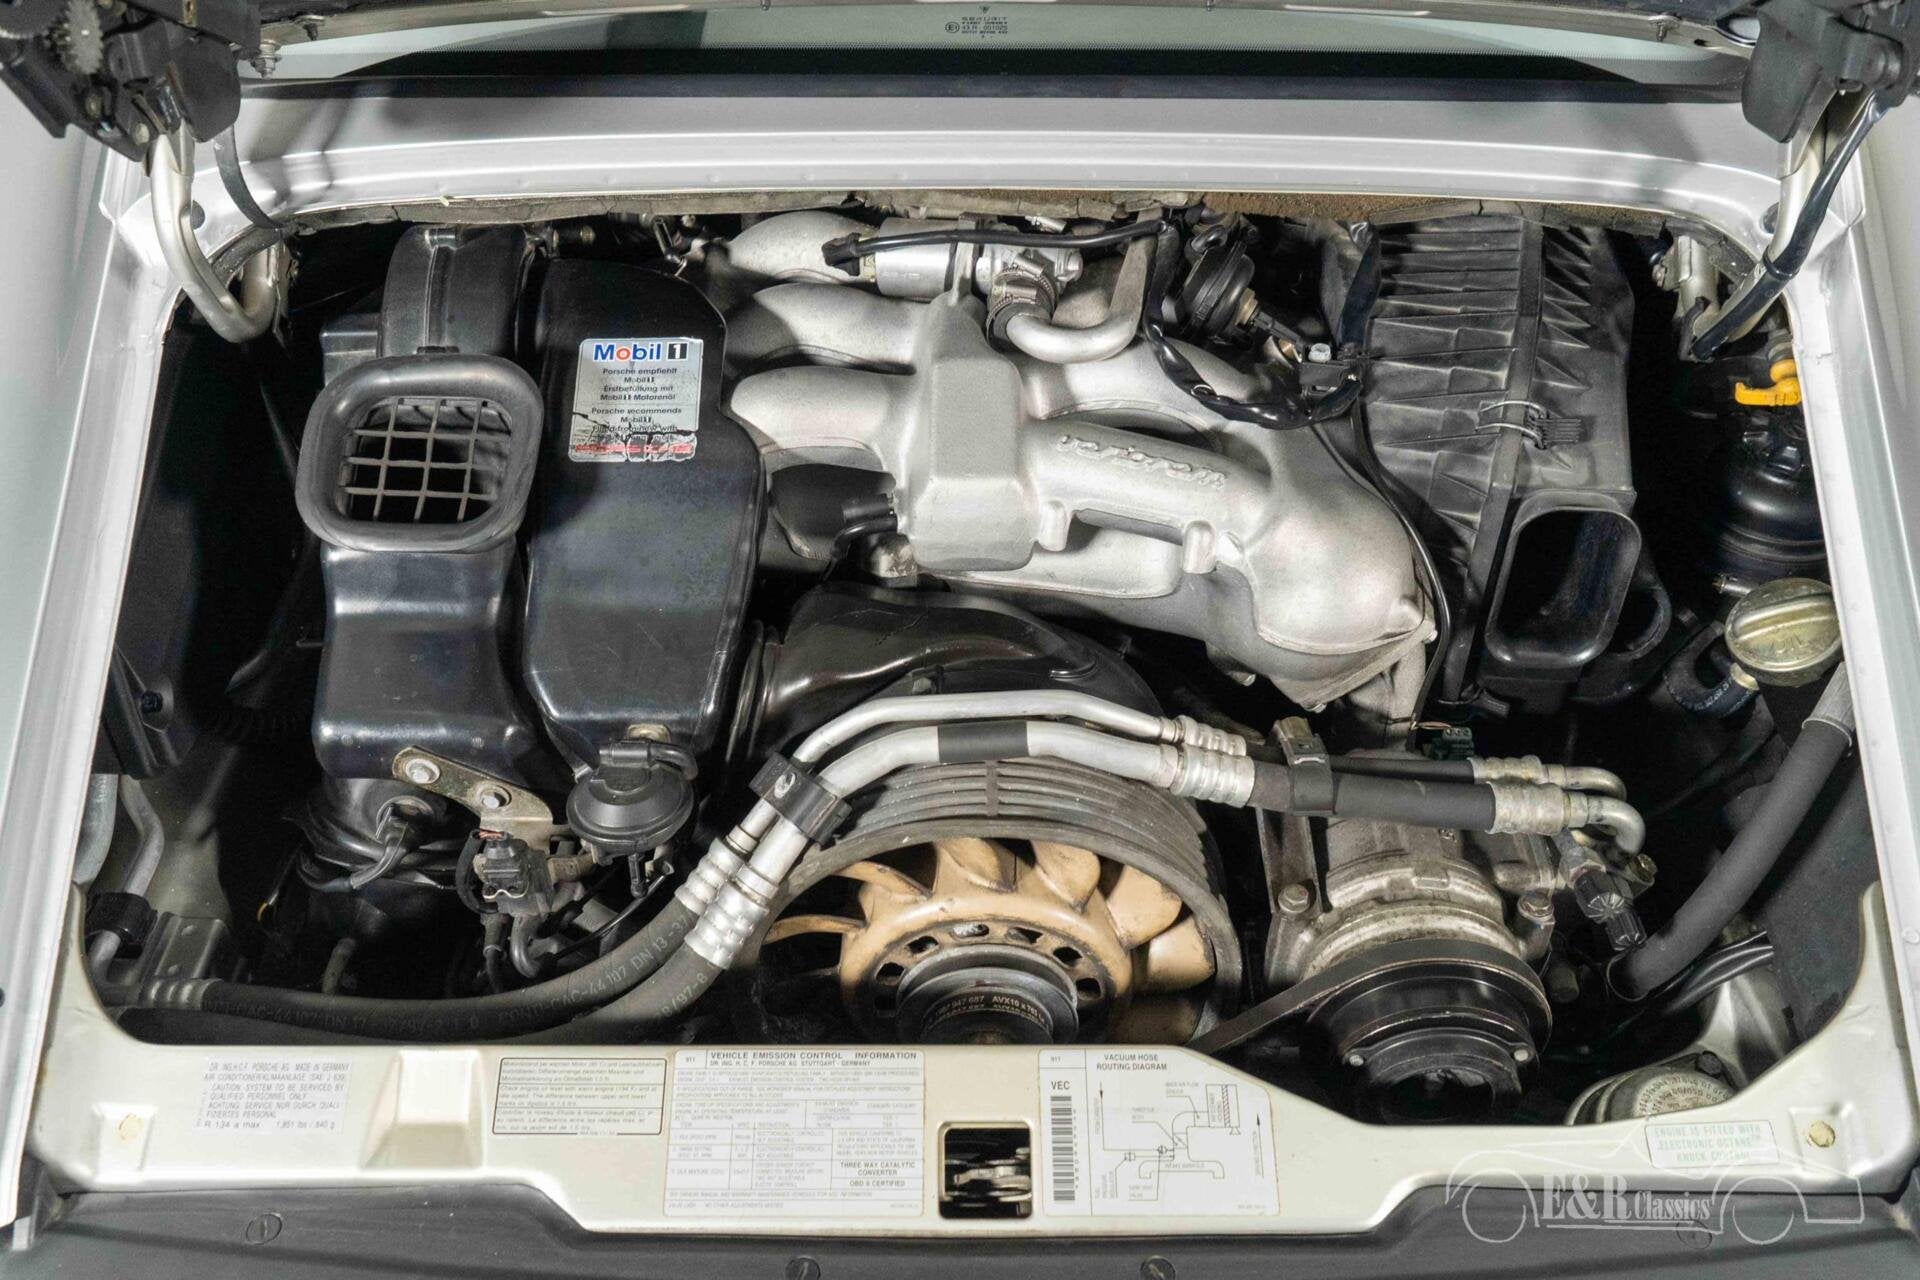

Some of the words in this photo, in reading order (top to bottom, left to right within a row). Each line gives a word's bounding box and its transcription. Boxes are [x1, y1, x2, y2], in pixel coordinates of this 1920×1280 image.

[594, 343, 661, 360] Mobil
[671, 343, 684, 359] 1
[638, 368, 678, 376] empfiehlt
[252, 1063, 278, 1071] PORSCHE
[295, 1063, 310, 1071] MADE
[322, 1063, 349, 1071] GERMANY
[1097, 1063, 1131, 1071] ROUTING
[1132, 1063, 1168, 1071] DIAGRAM
[212, 1083, 241, 1091] CAUTION
[245, 1083, 272, 1091] SYSTEM
[275, 1083, 284, 1091] TO
[288, 1083, 296, 1091] BE
[300, 1083, 331, 1091] SERVICED
[334, 1083, 344, 1091] BY
[1051, 1081, 1070, 1090] VEC
[243, 1121, 260, 1129] max
